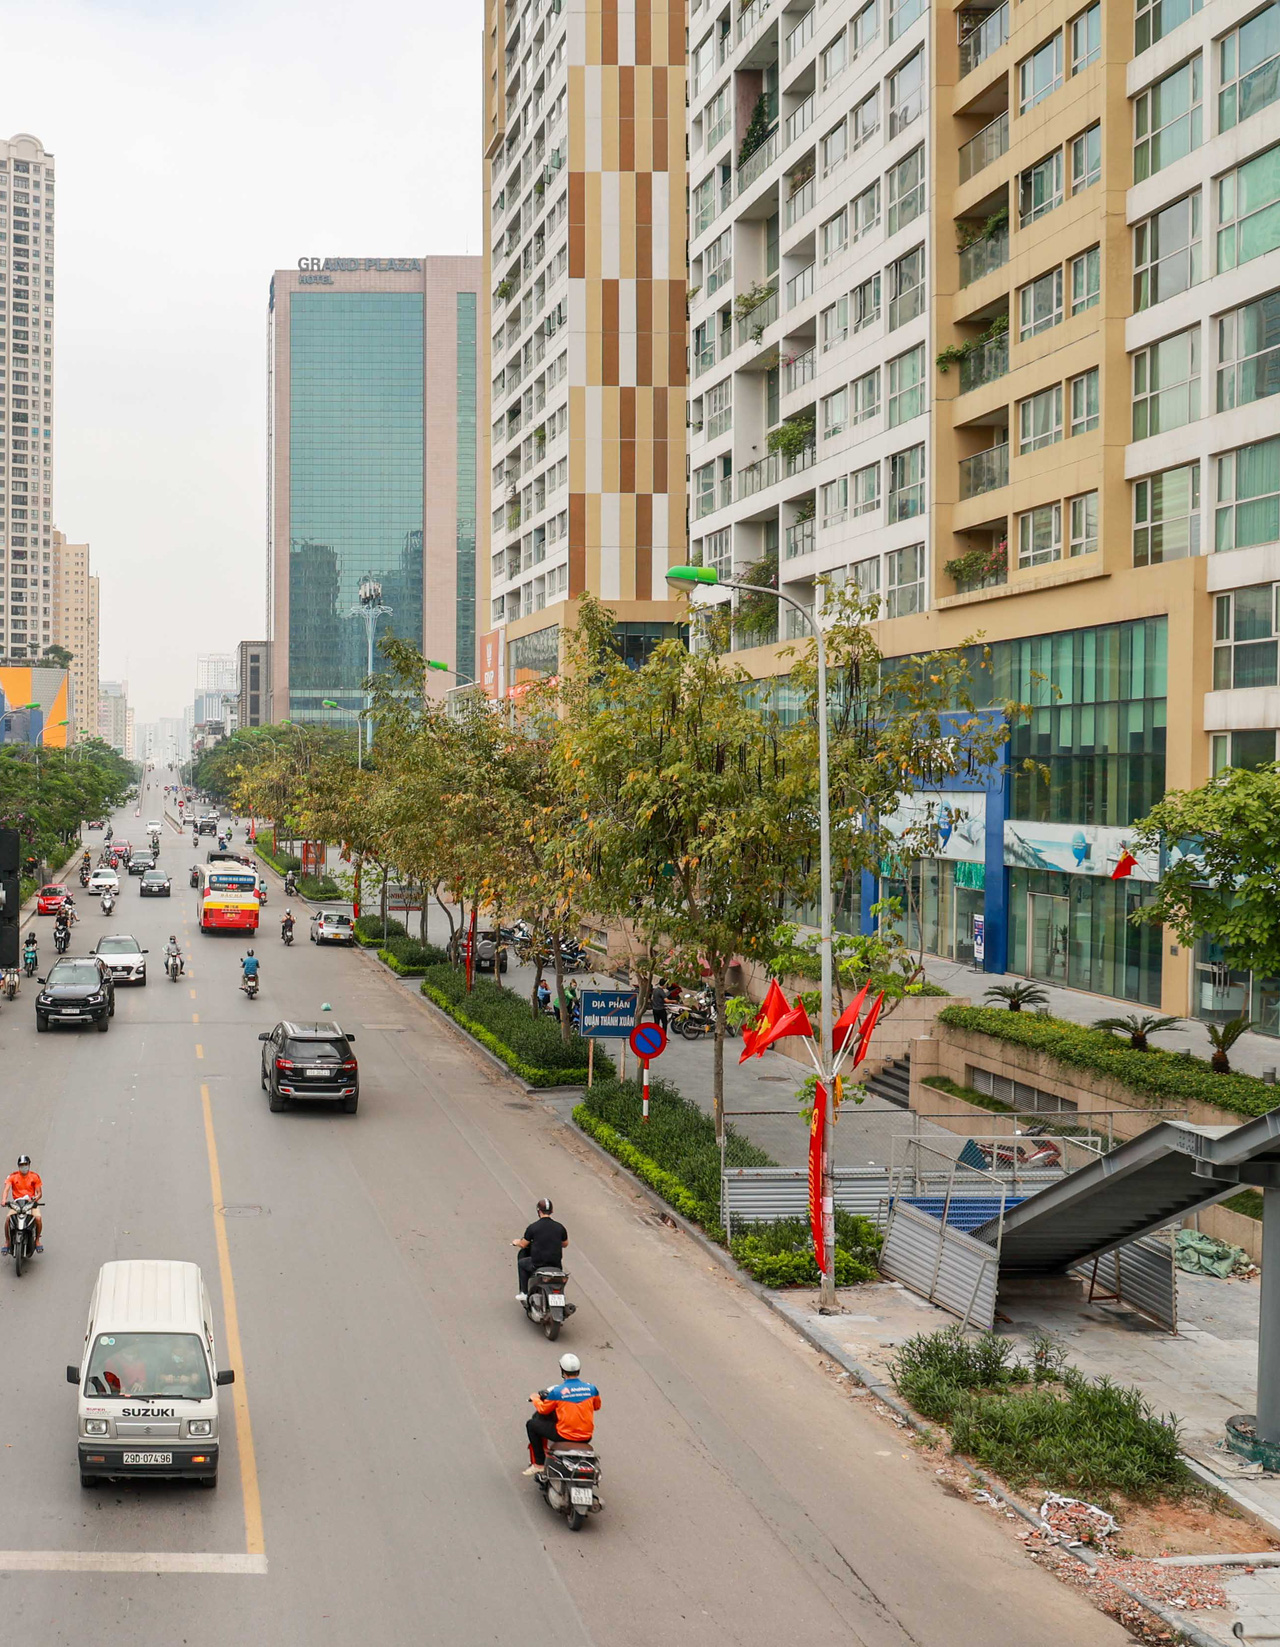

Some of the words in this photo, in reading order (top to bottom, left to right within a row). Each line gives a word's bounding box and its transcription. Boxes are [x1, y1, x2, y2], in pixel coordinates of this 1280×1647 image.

[297, 257, 359, 272] GRAND
[364, 257, 421, 272] PLAZA
[298, 274, 334, 285] HOTEL
[600, 1015, 619, 1026] THANH
[619, 1014, 635, 1027] XUÂN
[122, 1408, 175, 1417] SUZUKI
